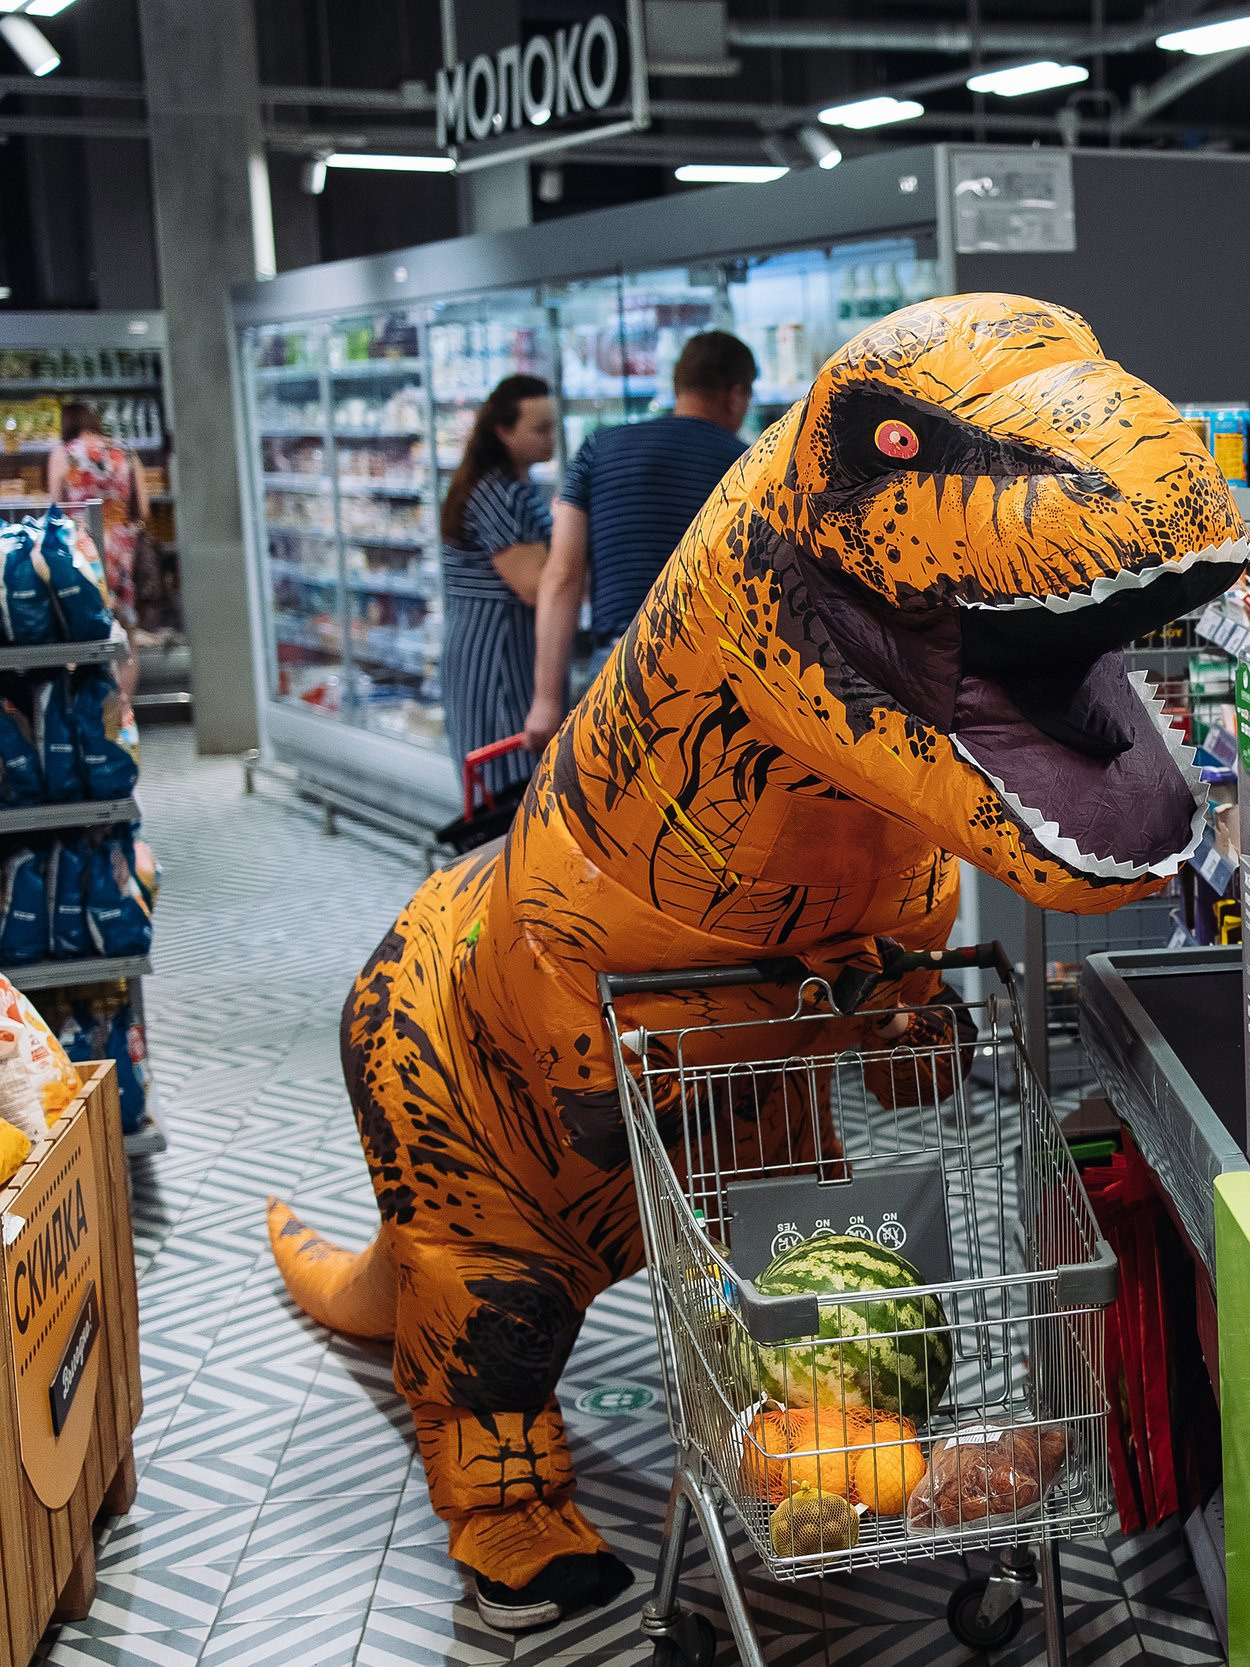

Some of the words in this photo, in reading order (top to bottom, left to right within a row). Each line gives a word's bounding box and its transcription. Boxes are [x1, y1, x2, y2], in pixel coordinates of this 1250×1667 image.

[435, 13, 619, 149] МОЛОКО
[849, 1215, 864, 1225] NO
[882, 1212, 898, 1222] NO
[777, 1222, 798, 1232] YES
[815, 1218, 831, 1228] NO
[13, 1177, 88, 1336] СКИДКА
